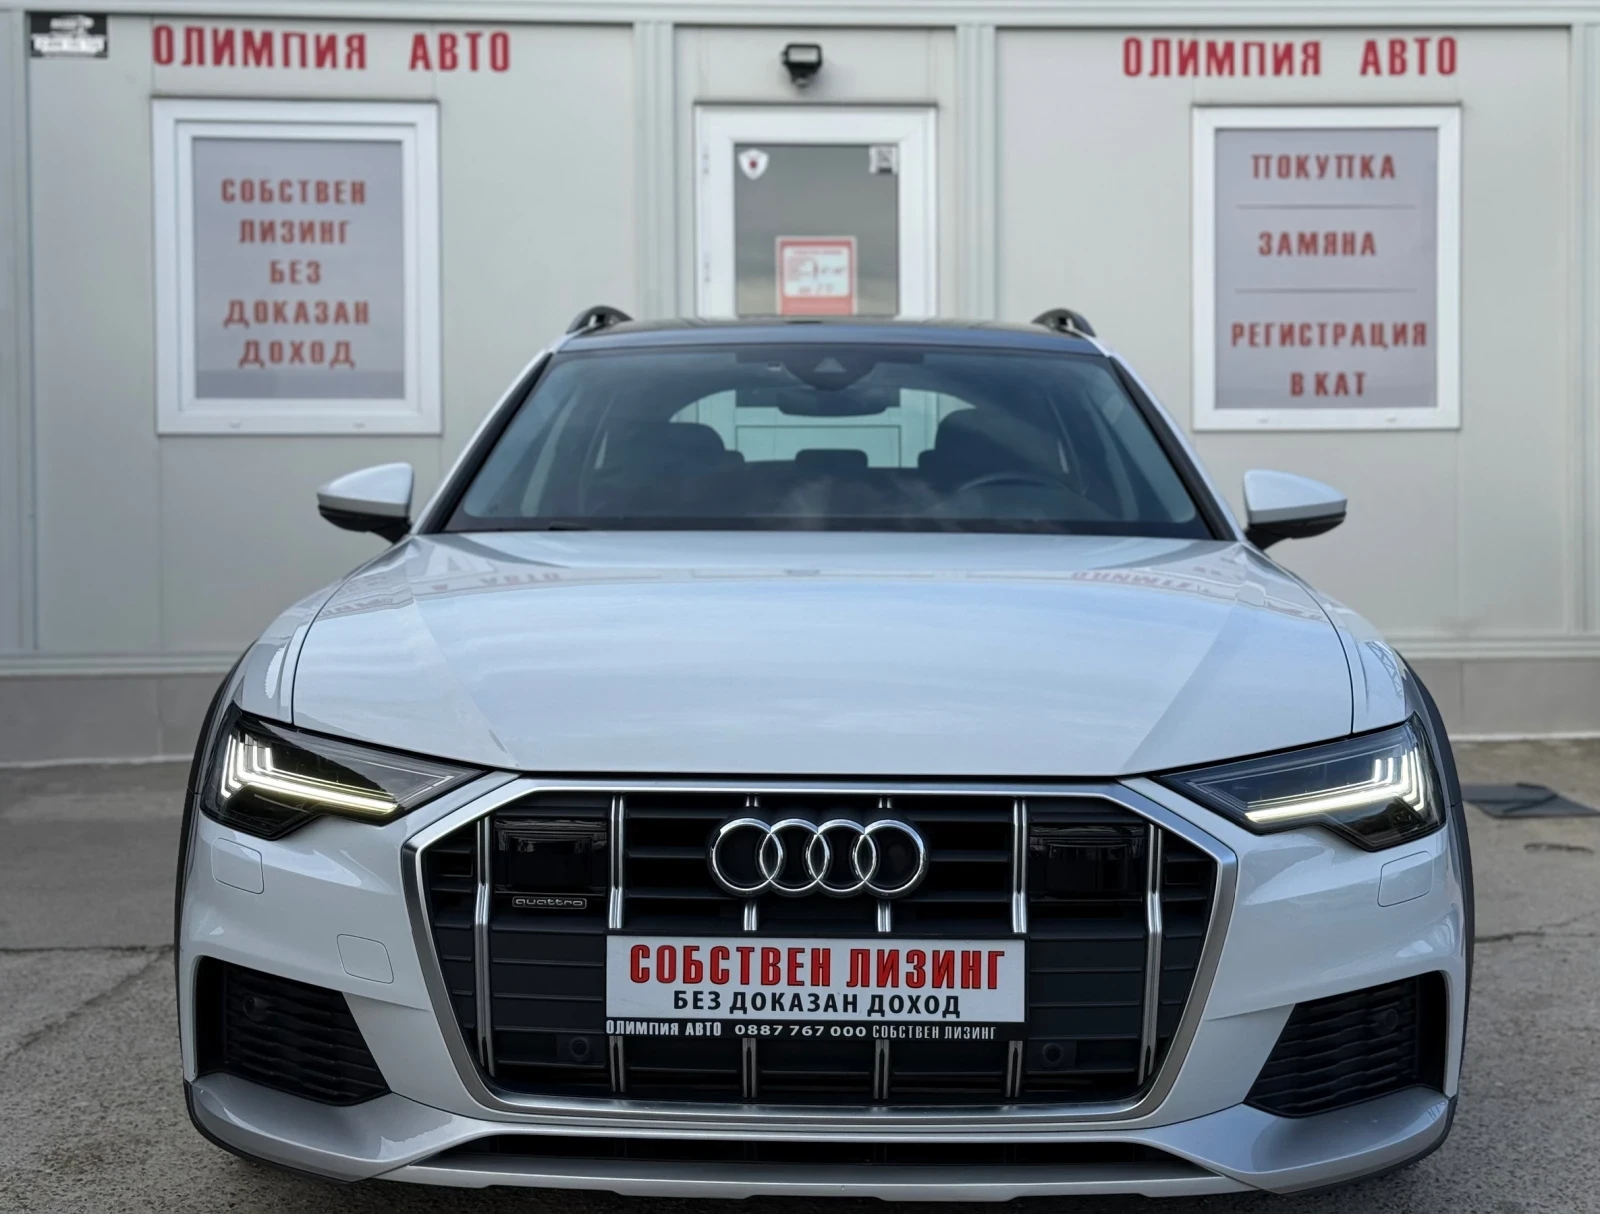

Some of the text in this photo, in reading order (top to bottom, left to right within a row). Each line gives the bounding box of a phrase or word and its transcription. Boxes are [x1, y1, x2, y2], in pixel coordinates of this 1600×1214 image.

[153, 24, 367, 69] ОЛИМПИЯ
[409, 31, 511, 73] АВТО
[1123, 36, 1457, 77] ОЛИМПИЯ АВТО
[1252, 154, 1396, 180] ПОКУПКА
[221, 178, 366, 205] СОБСТВЕН
[239, 219, 351, 245] ЛИЗИНГ
[1258, 232, 1377, 257] ЗАМЯНА
[269, 260, 322, 285] БЕЗ
[223, 300, 370, 327] ДОКАЗАН
[1231, 322, 1428, 349] РЕГИСТРАЦИЯ
[239, 341, 356, 369] ДОХОД
[1290, 371, 1367, 397] В КАТ
[515, 898, 583, 907] quattro
[630, 944, 1005, 990] СОБСТВЕН ЛИЗИНГ
[674, 990, 960, 1019] БЕЗ ДОКАЗАН ДОХОД
[606, 1020, 996, 1040] ОЛИМПИЯ АВТО 0887 767 000 СОБСТВЕН ЛИЗИНГ
